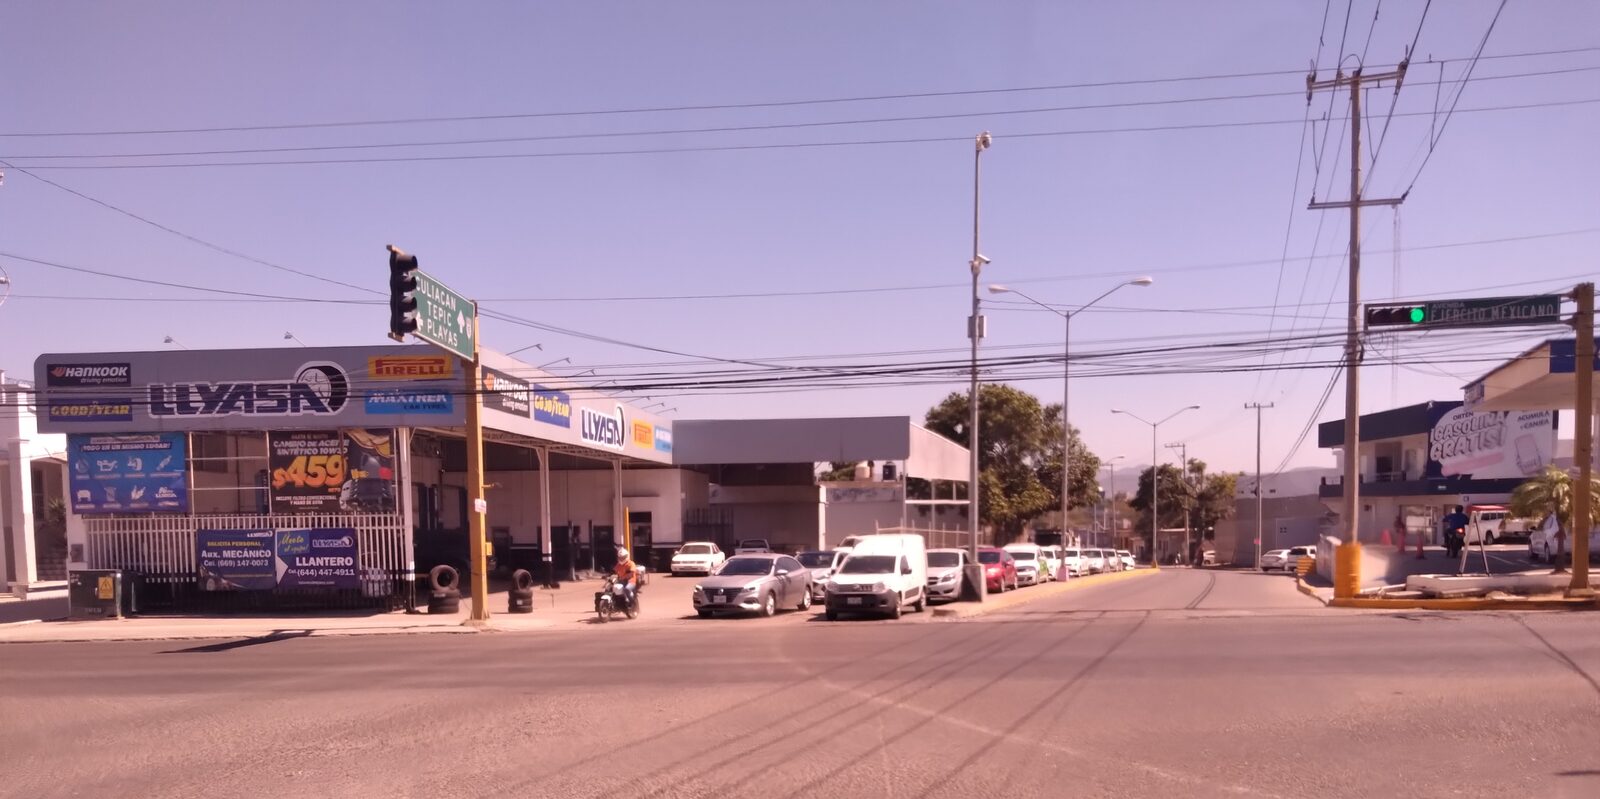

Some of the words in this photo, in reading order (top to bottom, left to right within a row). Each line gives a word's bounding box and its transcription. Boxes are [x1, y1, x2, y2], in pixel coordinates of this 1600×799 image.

[415, 276, 456, 312] CULIACAN
[427, 301, 452, 327] TEPIC
[1431, 308, 1486, 322] EJERCITO
[1491, 304, 1554, 321] MEXICANO
[427, 319, 458, 347] PLAYAS
[375, 358, 445, 375] PIRELLI
[148, 378, 338, 418] LLYASA
[51, 401, 130, 417] GOODYEAR
[581, 406, 624, 448] LLYASA
[273, 440, 306, 448] CAMBIO
[272, 454, 347, 490] $459
[312, 536, 353, 548] LLYASA
[201, 550, 221, 558] Aux.
[222, 547, 272, 558] MECÁNICO
[295, 557, 354, 567] LLANTERO
[318, 568, 355, 576] 447-4911
